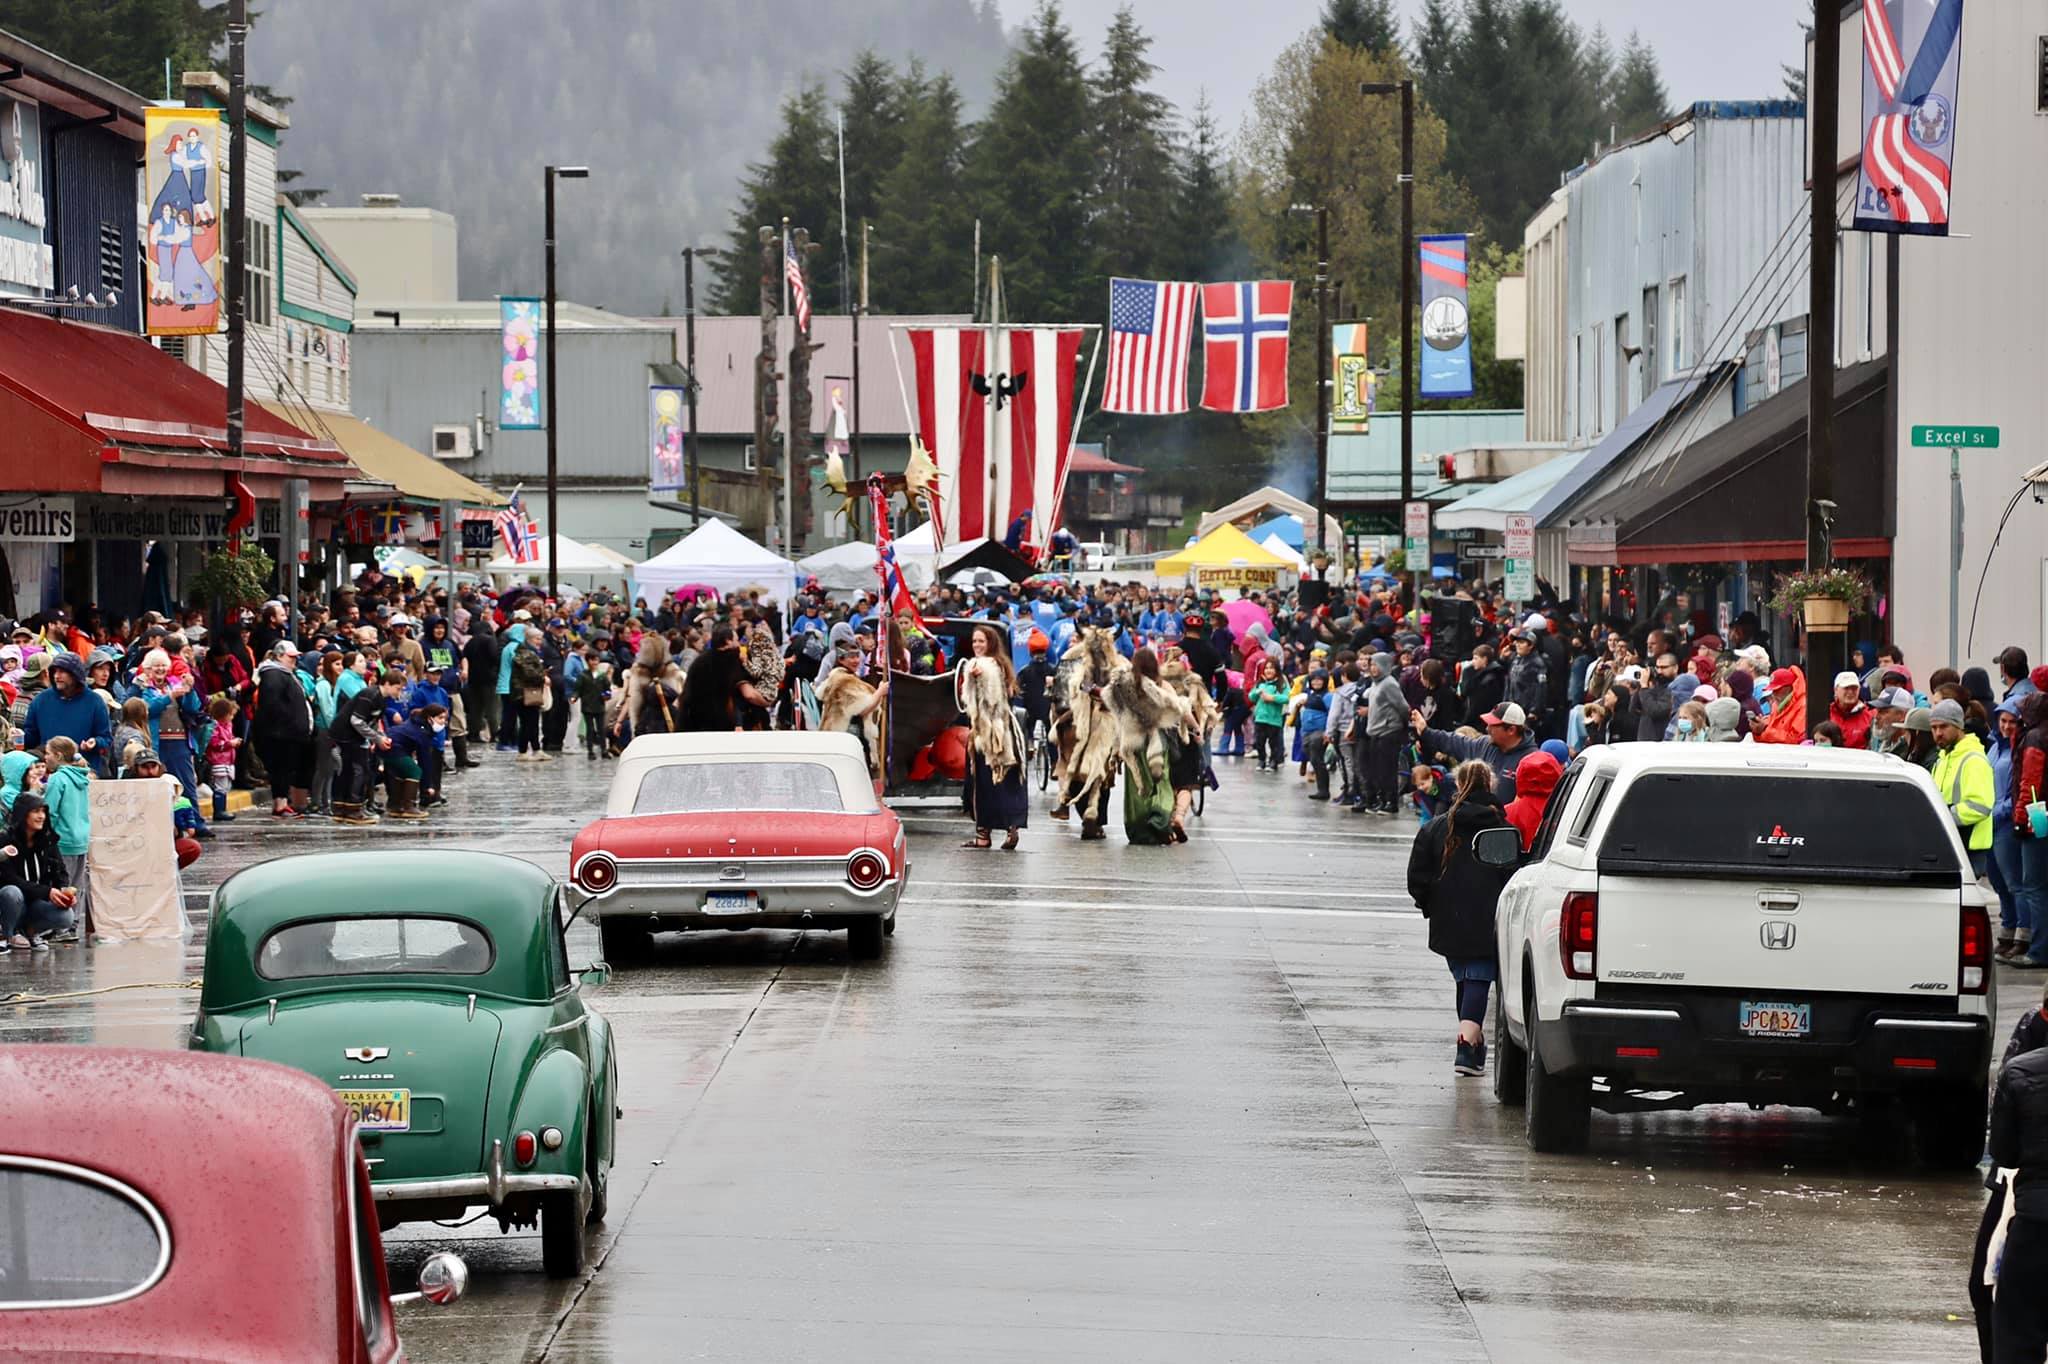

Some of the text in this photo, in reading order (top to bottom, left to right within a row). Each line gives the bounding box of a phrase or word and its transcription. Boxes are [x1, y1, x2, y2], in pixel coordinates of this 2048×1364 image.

[1925, 429, 1985, 443] Excel St
[90, 506, 164, 538] Norwegian
[169, 507, 200, 536] Gifts
[1514, 519, 1526, 528] NO
[1199, 568, 1277, 584] KETTLE CORN
[1756, 836, 1805, 846] LEER
[1909, 982, 1949, 990] AWD
